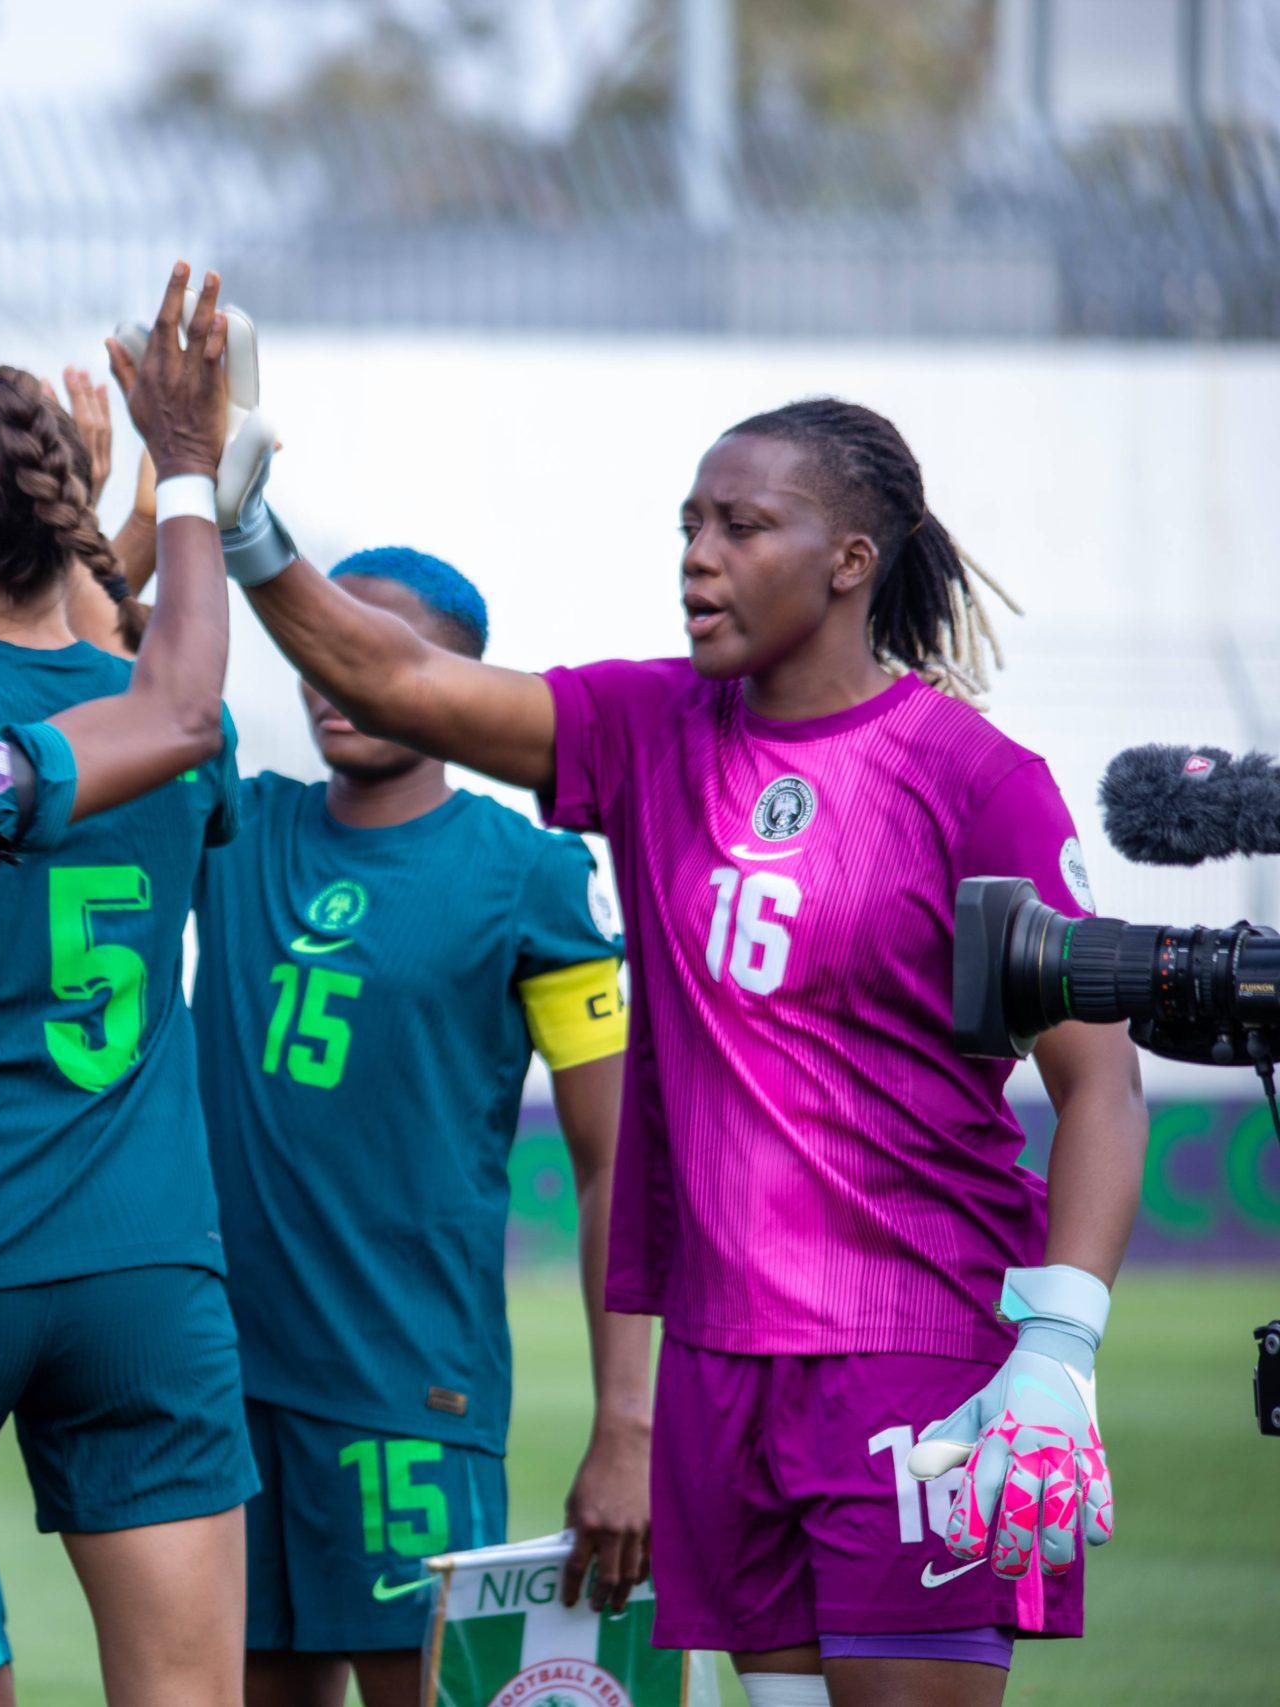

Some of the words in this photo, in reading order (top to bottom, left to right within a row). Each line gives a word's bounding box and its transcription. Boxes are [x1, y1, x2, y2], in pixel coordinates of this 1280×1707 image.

[43, 865, 152, 1093] 5
[705, 867, 803, 996] 16
[261, 963, 363, 1089] 15
[338, 1438, 449, 1557] 15
[495, 1665, 585, 1707] OOTBALL
